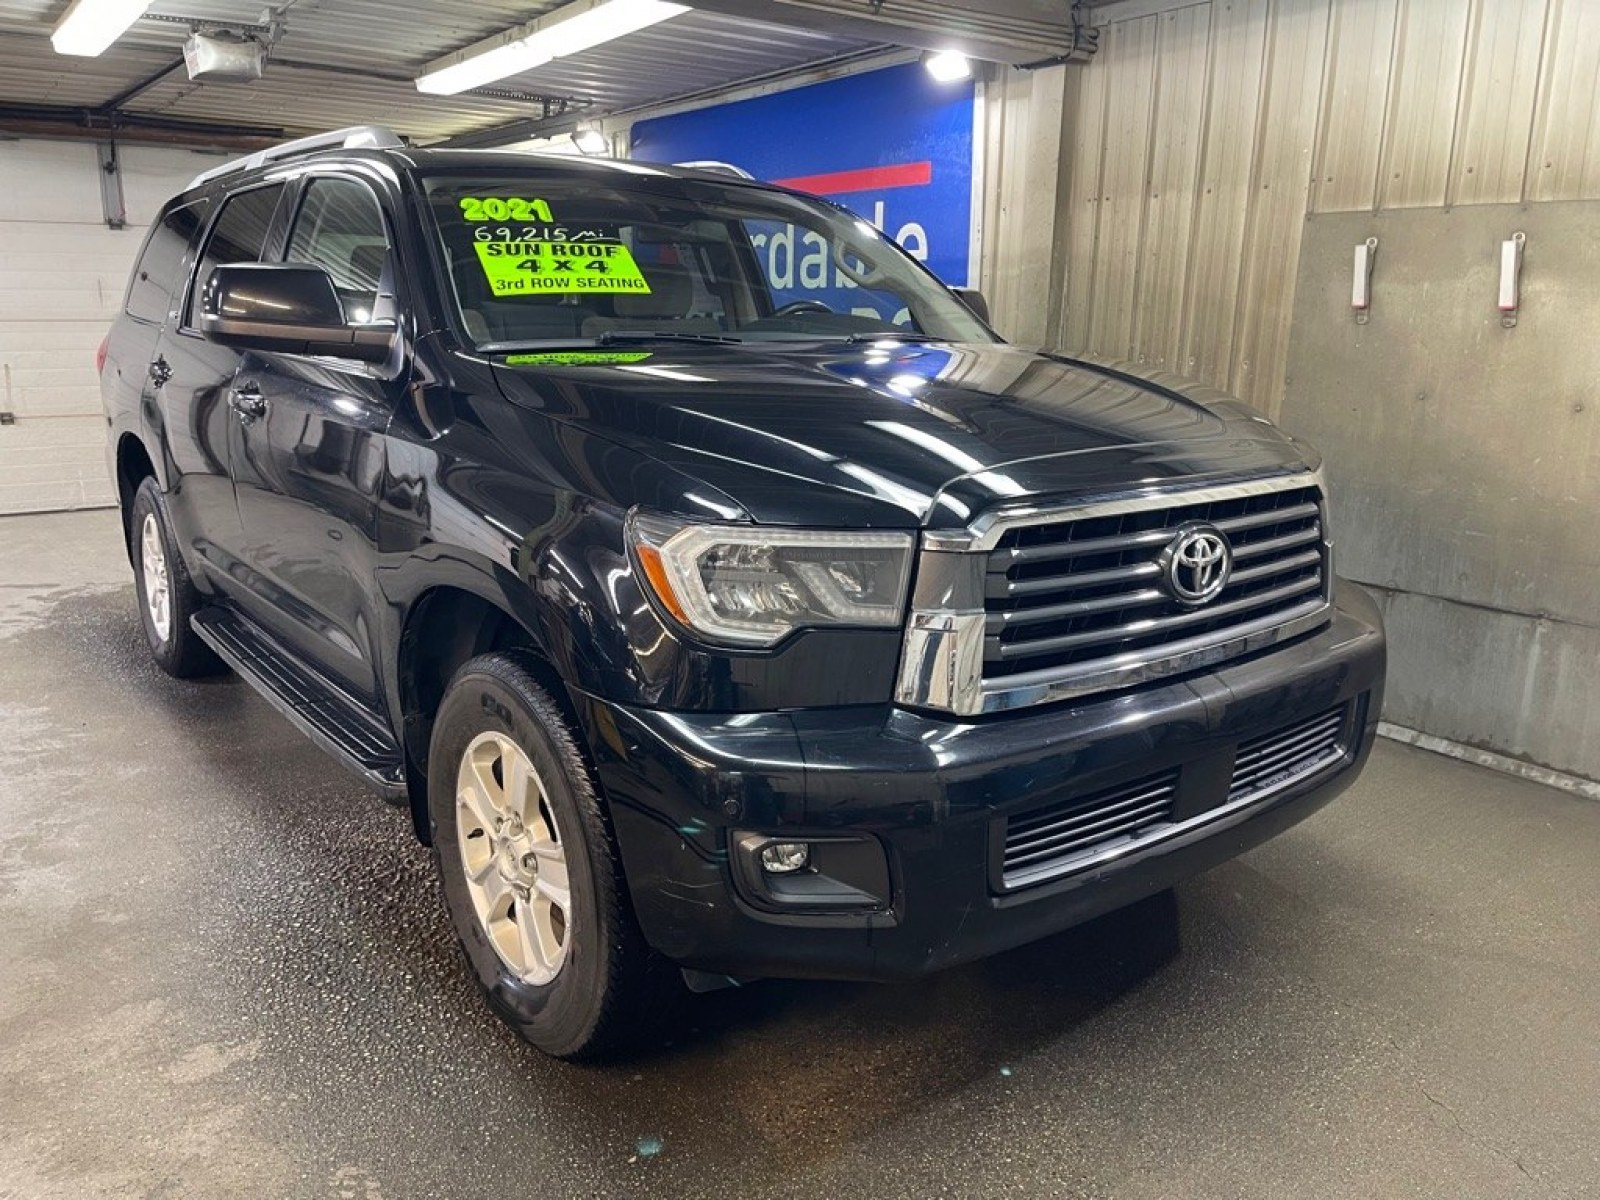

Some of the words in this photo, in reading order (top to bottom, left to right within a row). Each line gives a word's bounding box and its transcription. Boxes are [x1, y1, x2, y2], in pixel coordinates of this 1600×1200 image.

[460, 197, 554, 223] 2021
[474, 226, 569, 243] 69,215
[487, 243, 543, 256] SUN
[551, 244, 620, 258] ROOF
[750, 201, 928, 290] dae
[516, 259, 543, 274] 4
[585, 260, 611, 274] 4
[496, 278, 525, 290] 3rd
[531, 277, 570, 289] ROW
[577, 277, 645, 289] SEATING
